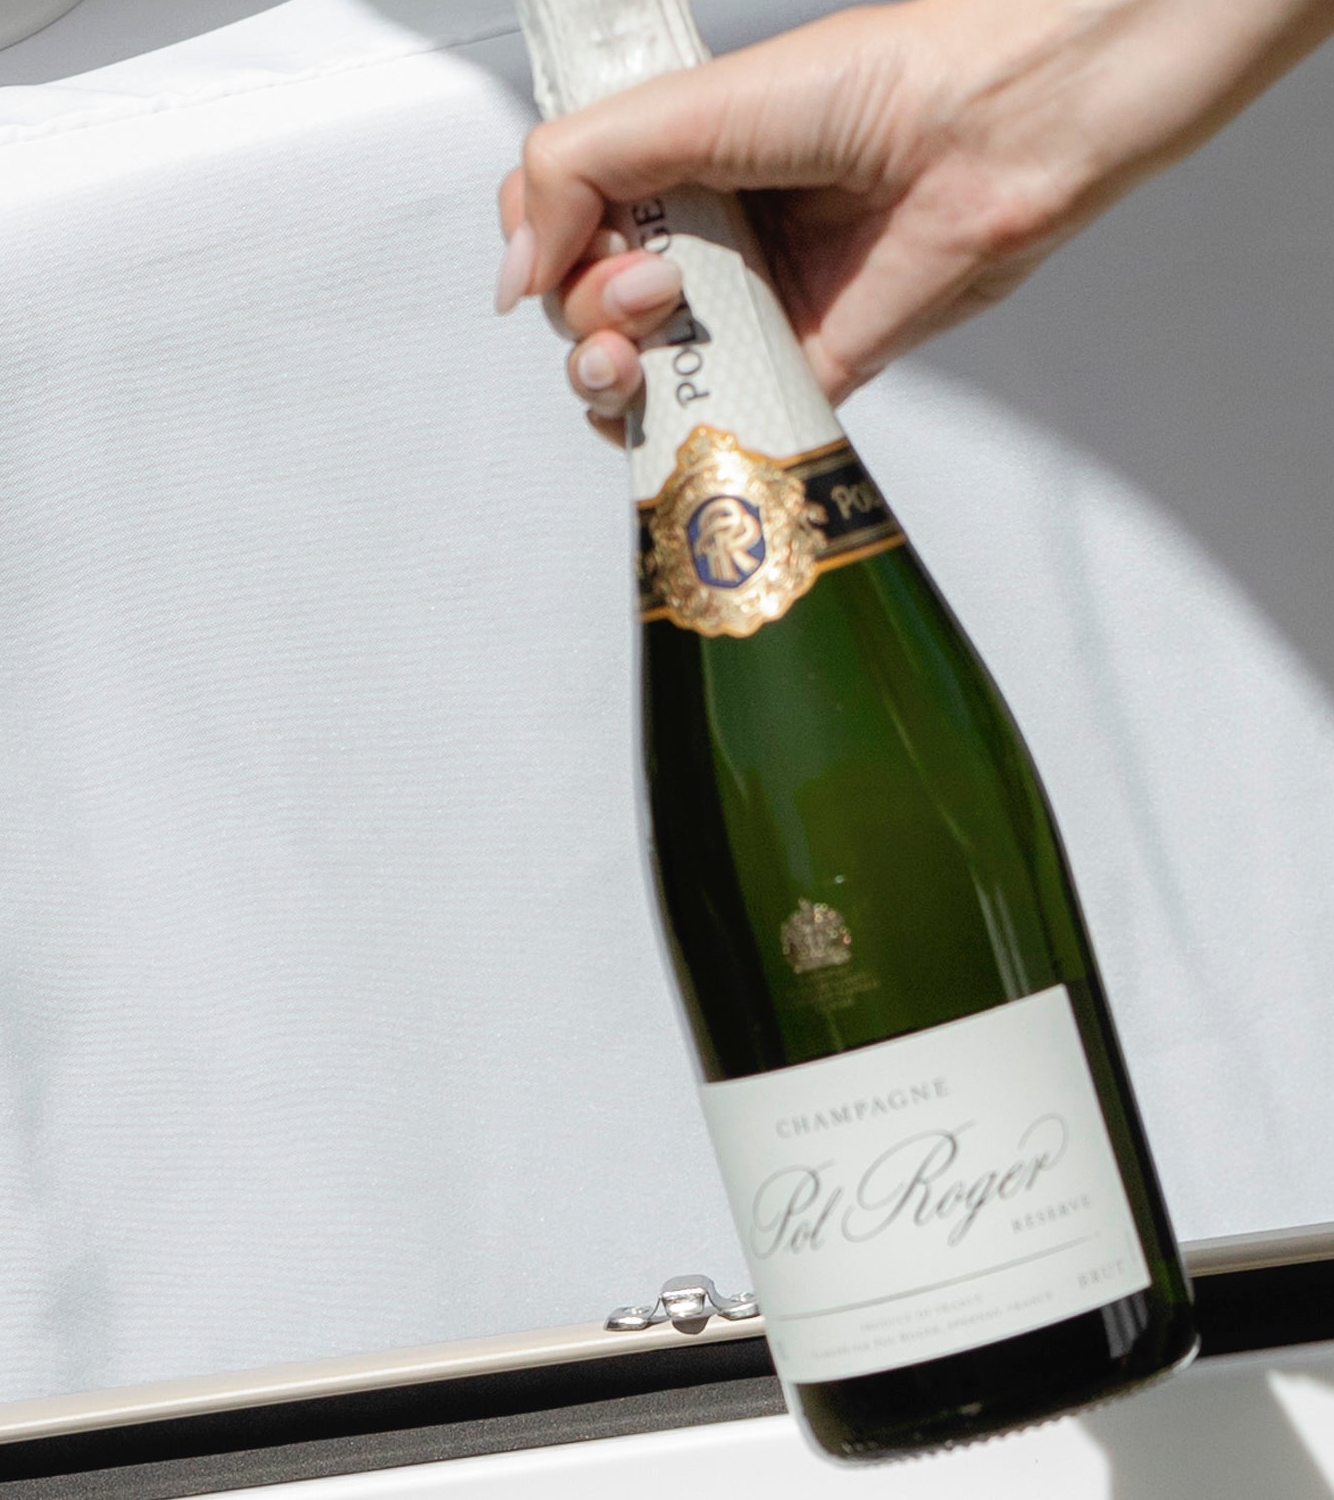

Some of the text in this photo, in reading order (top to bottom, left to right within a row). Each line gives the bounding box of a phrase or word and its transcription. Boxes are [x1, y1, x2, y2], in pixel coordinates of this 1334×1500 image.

[774, 1077, 951, 1140] CHAMPAGNE
[748, 1112, 1069, 1261] Pol Roger
[1076, 1257, 1126, 1289] BRUT
